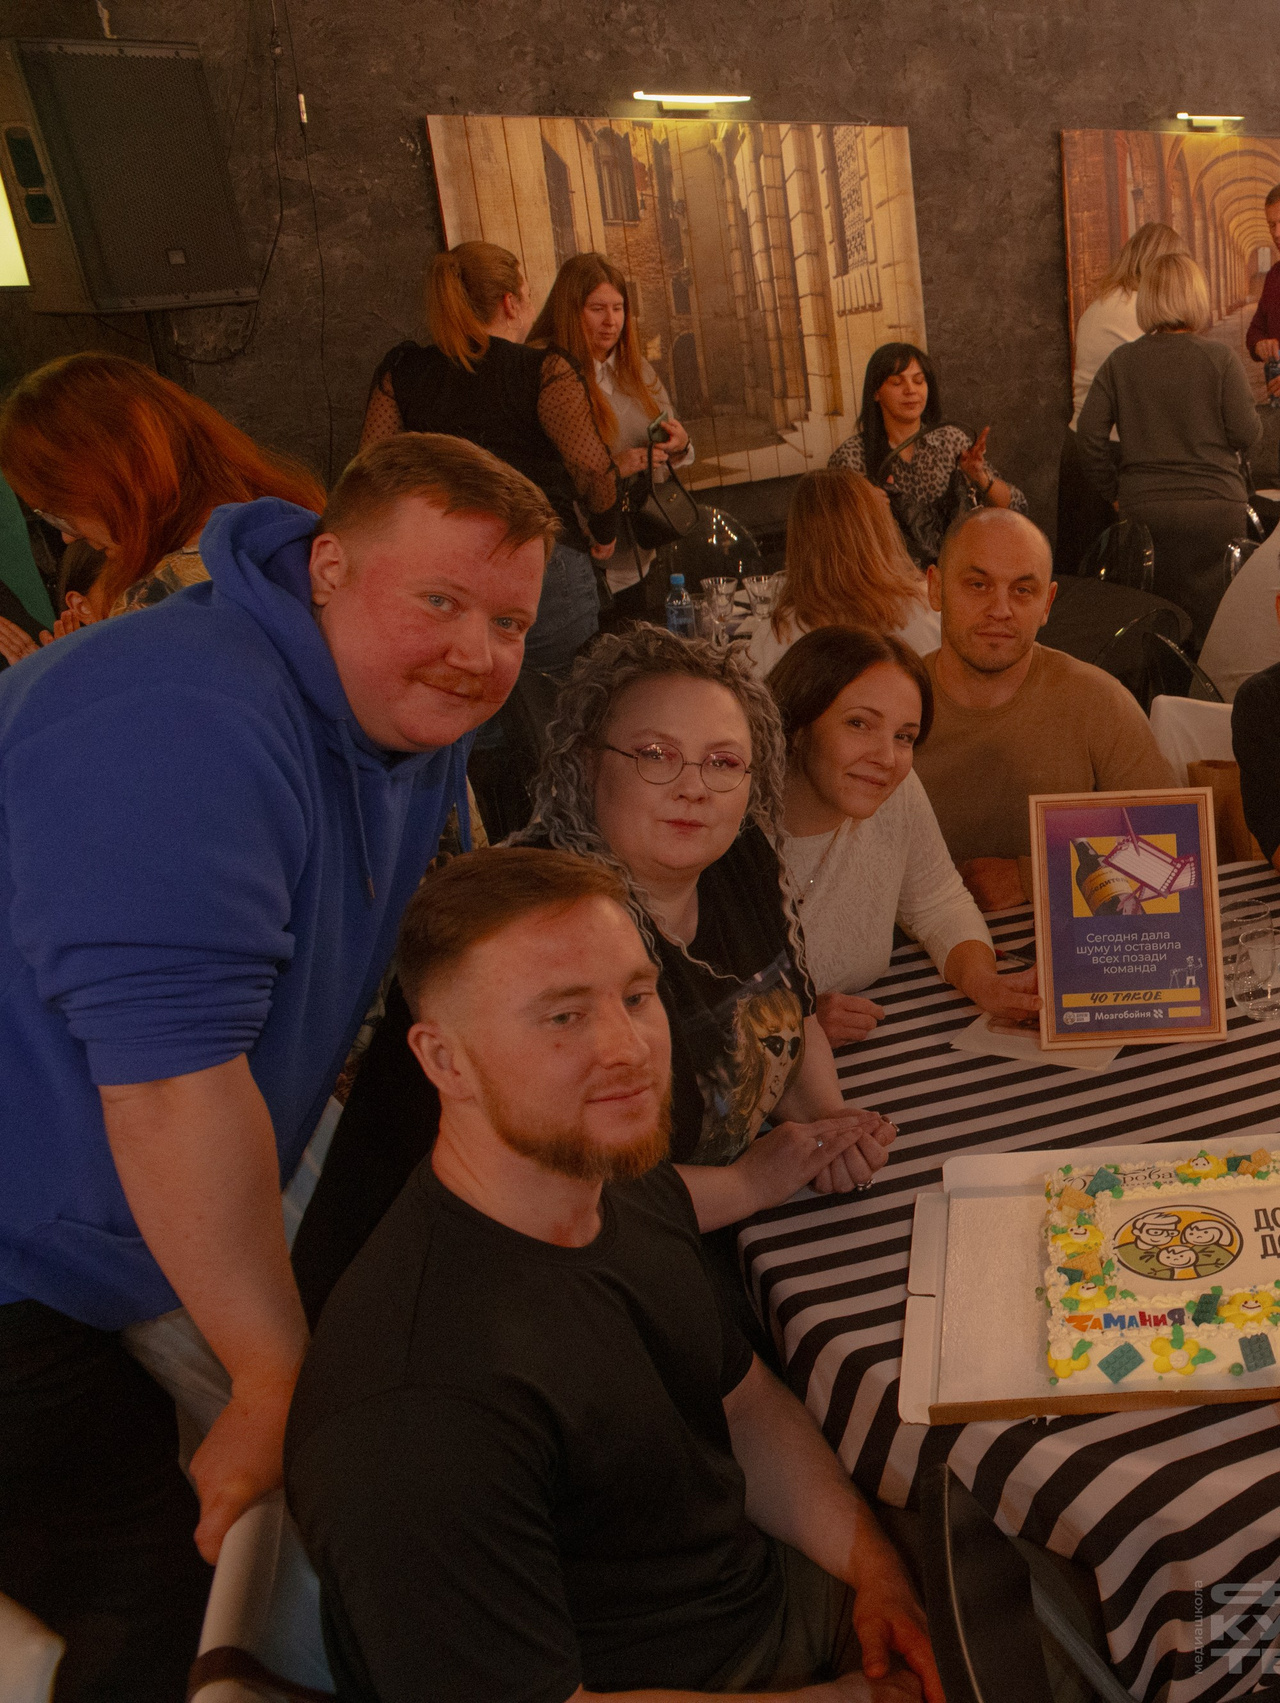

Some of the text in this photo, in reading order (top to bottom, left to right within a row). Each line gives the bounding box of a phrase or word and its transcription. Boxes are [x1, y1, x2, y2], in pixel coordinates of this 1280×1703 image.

[1086, 930, 1171, 945] Сегодня дала
[1076, 940, 1182, 957] шуму и оставила
[1092, 951, 1168, 965] всех позади
[1103, 962, 1157, 975] команда
[1113, 991, 1163, 1003] ТАКОЕ
[1095, 1010, 1151, 1021] Мозгобойня
